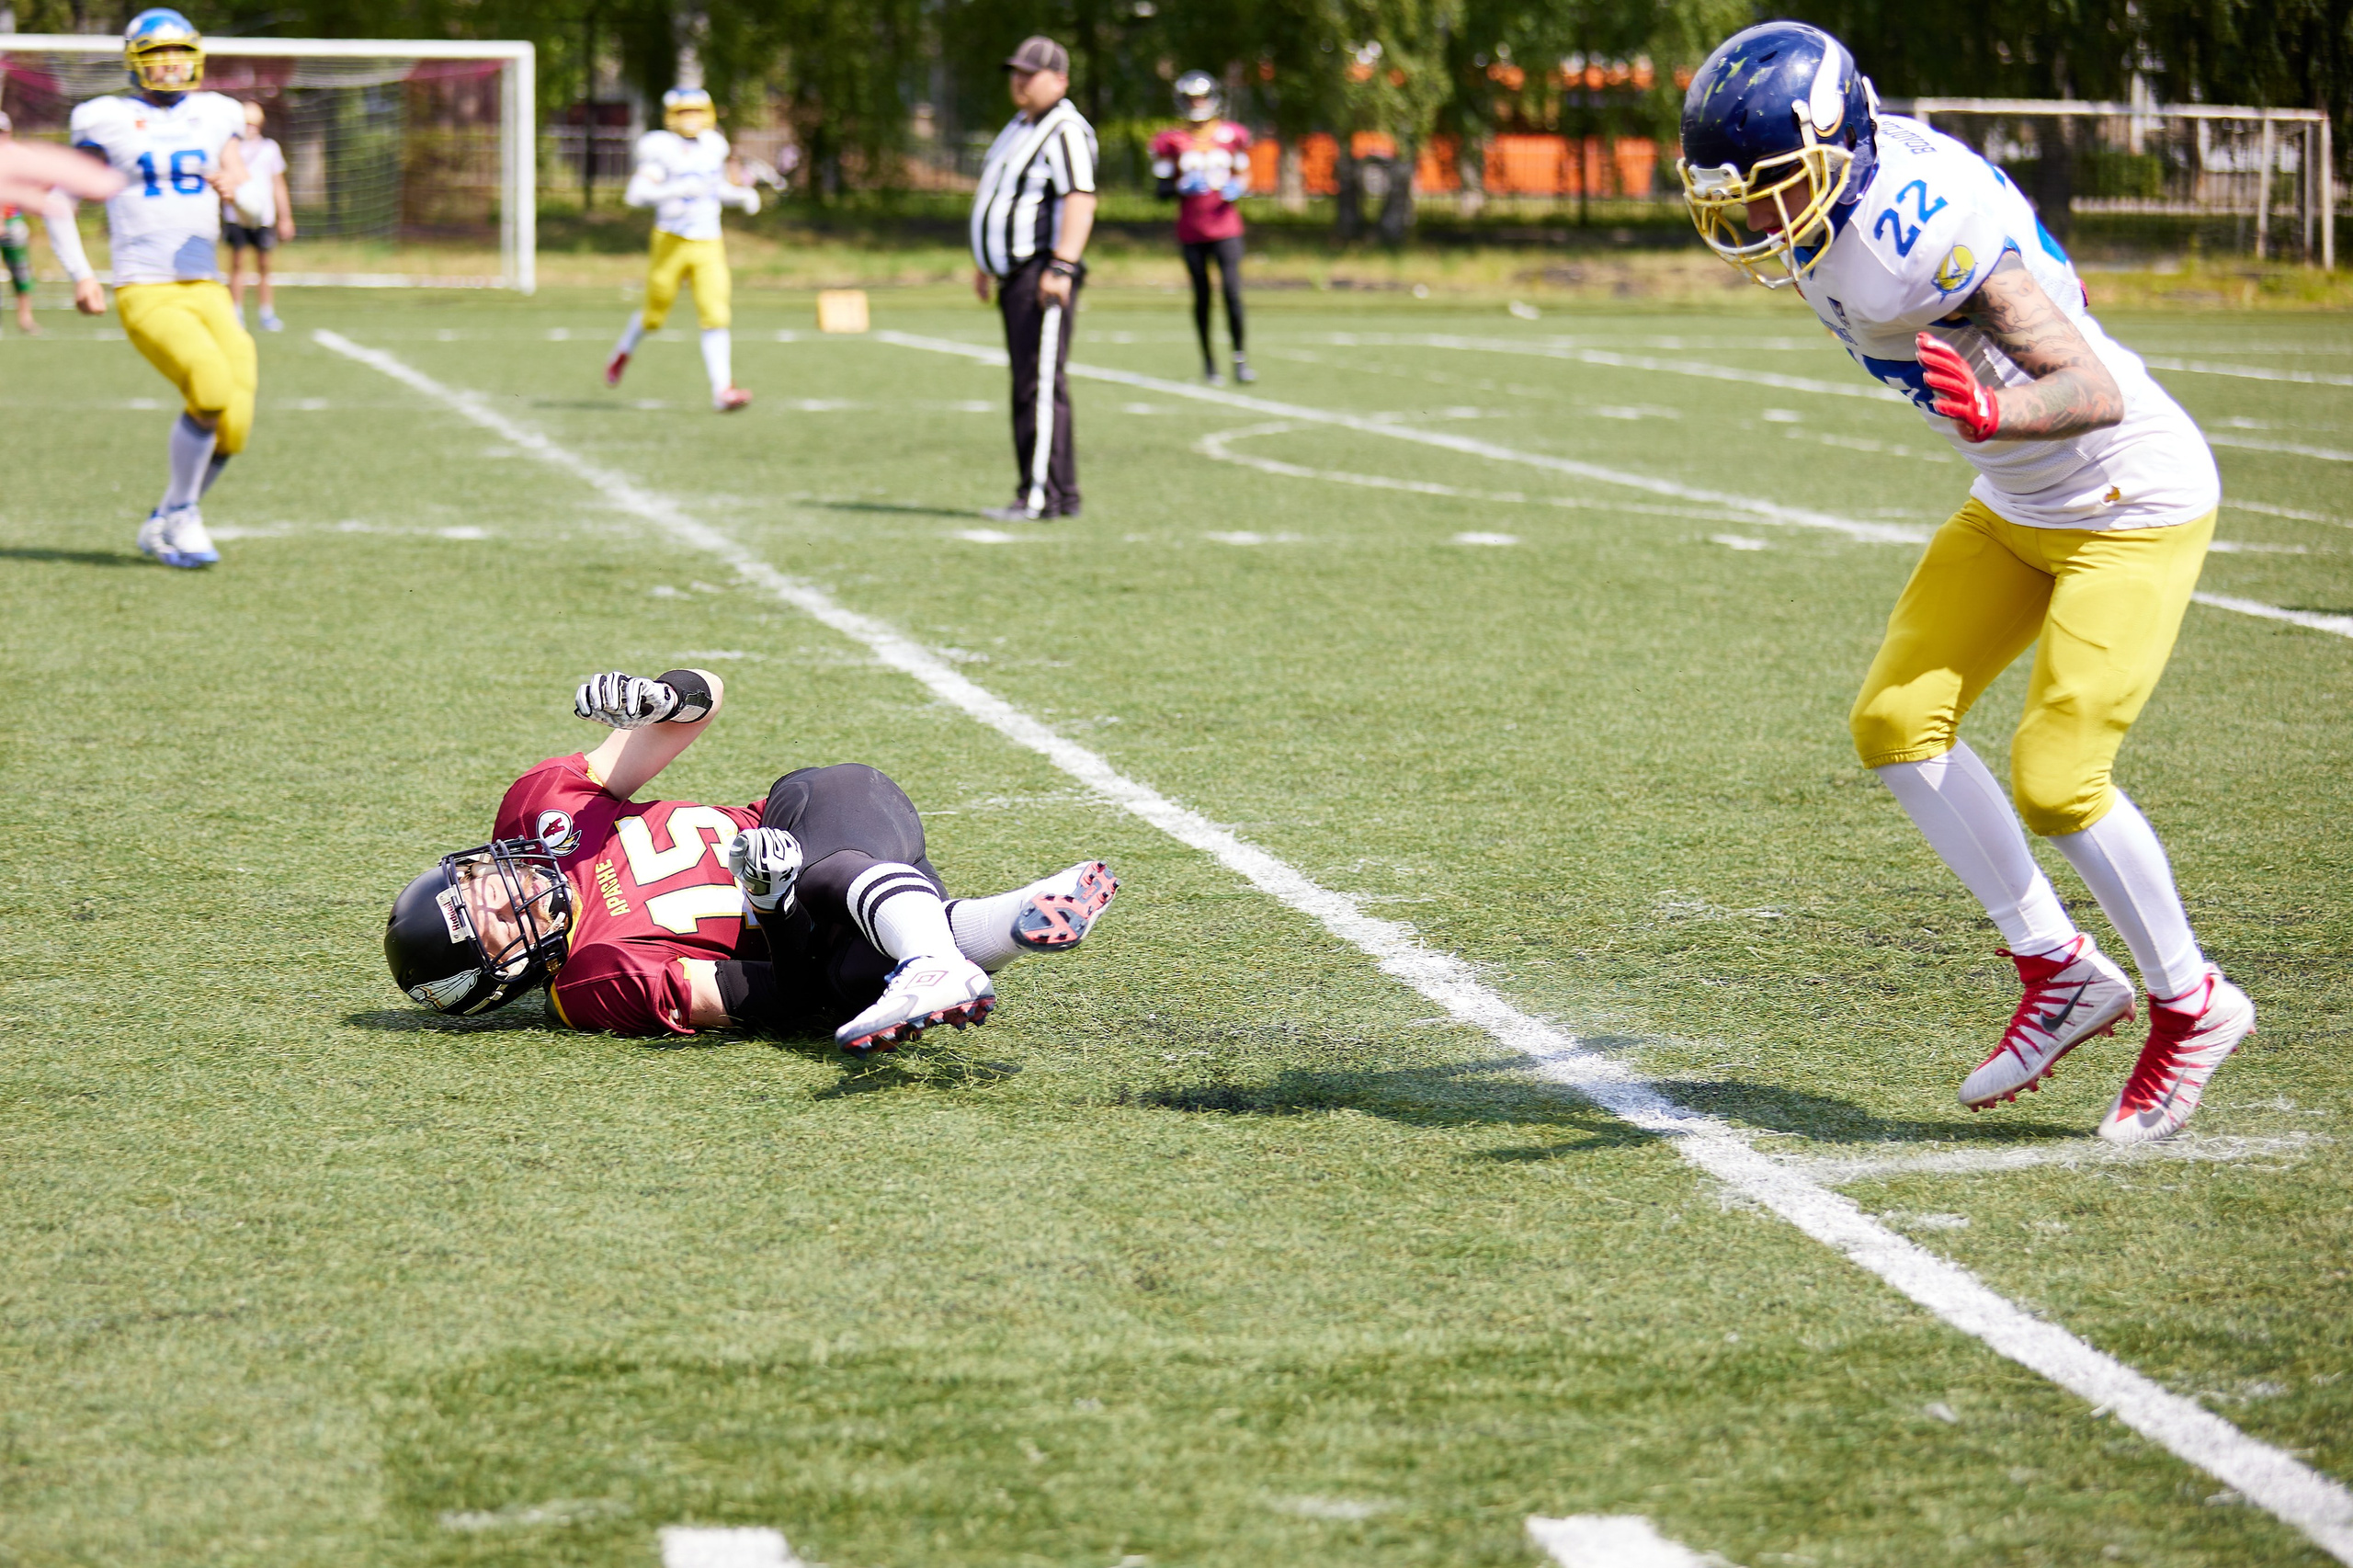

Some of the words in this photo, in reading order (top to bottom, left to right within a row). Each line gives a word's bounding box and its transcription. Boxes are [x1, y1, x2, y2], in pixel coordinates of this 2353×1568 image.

[137, 149, 207, 197] 16
[1873, 179, 1949, 258] 22
[596, 858, 631, 917] APACHE
[614, 805, 761, 935] 15
[442, 900, 460, 932] Riddell
